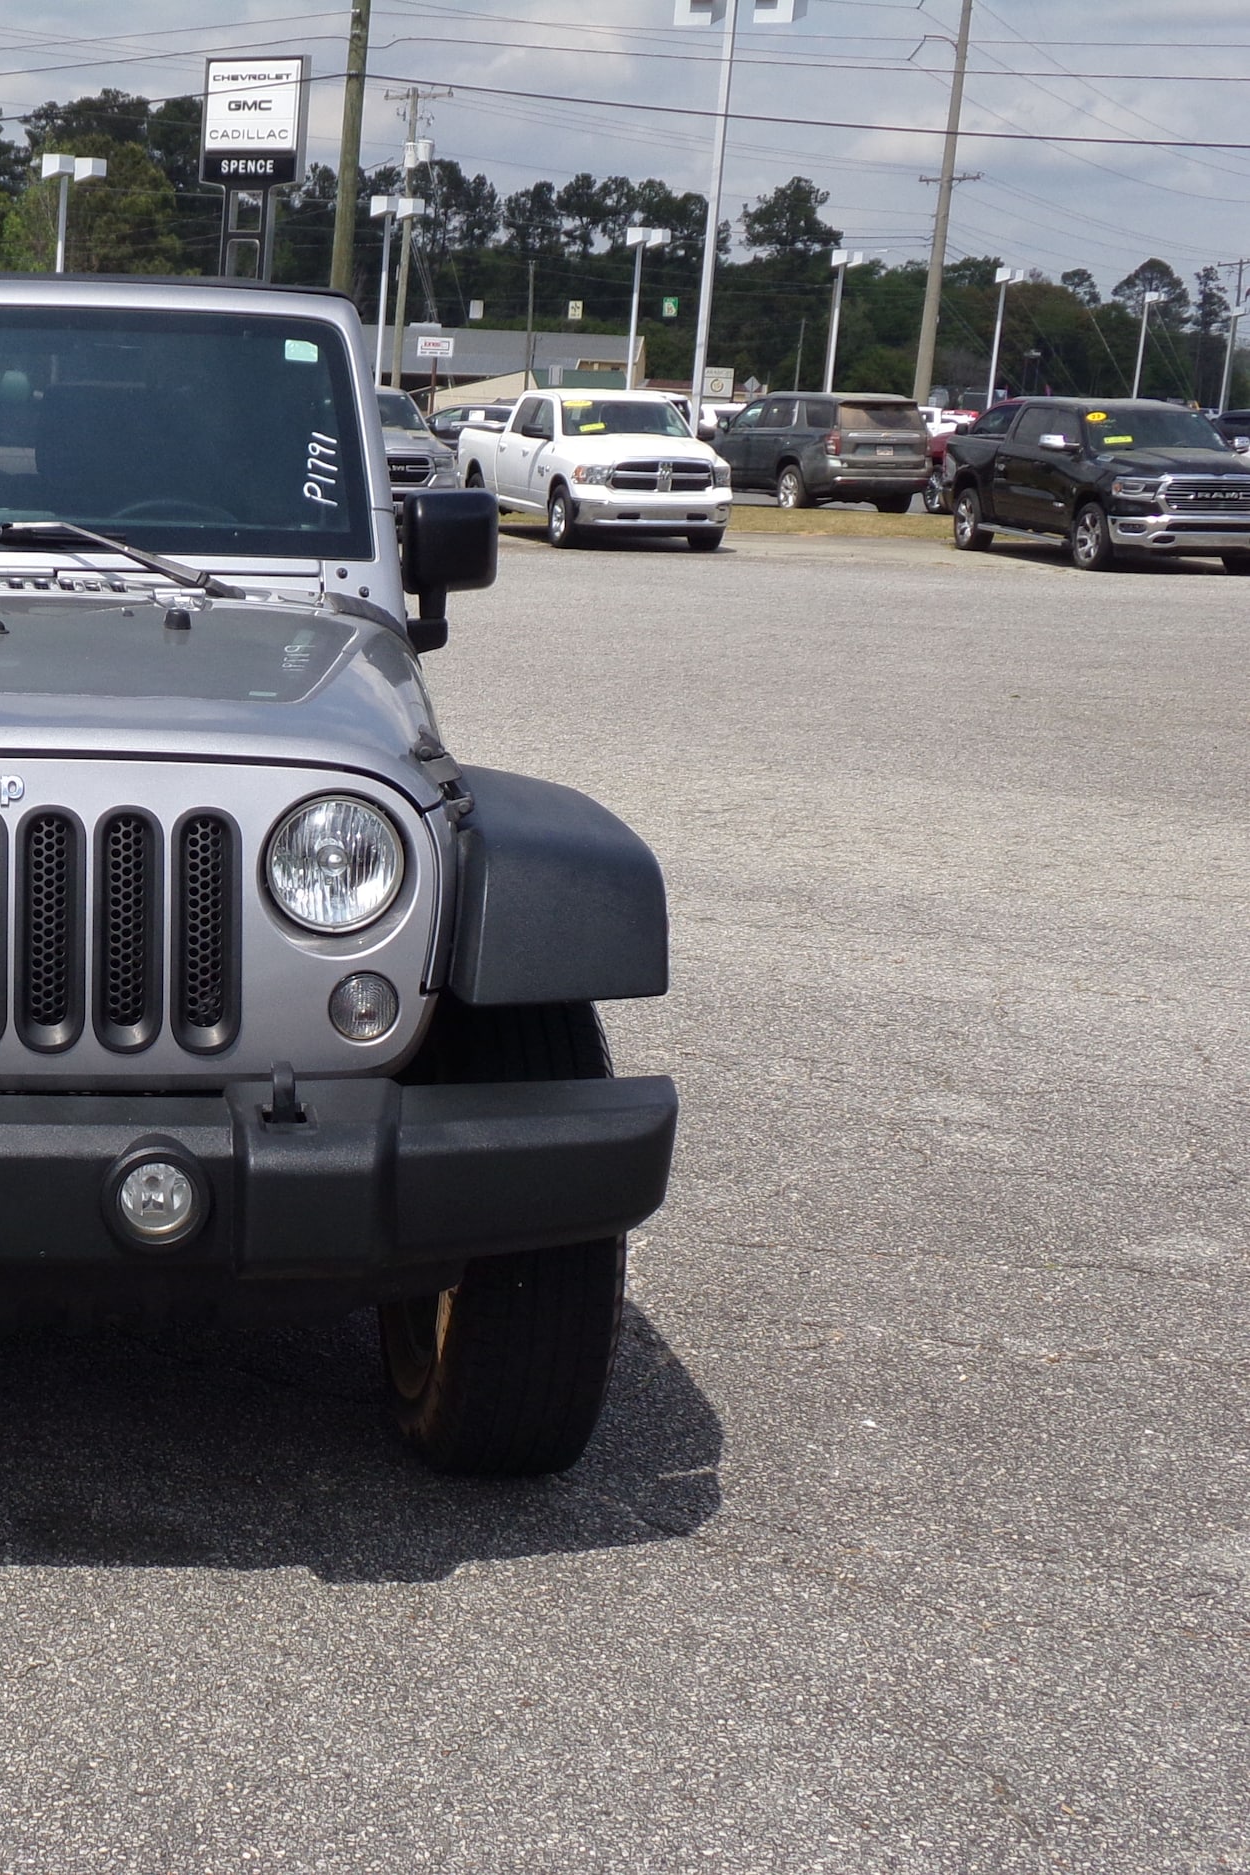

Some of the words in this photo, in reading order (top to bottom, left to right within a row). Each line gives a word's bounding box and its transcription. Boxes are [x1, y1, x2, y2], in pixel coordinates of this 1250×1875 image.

[213, 73, 292, 82] CHEVROLET
[228, 100, 272, 111] GMC
[209, 129, 288, 140] CADILLAC
[221, 159, 274, 173] SPENCE
[303, 431, 338, 507] P1791
[1197, 491, 1240, 499] RAM
